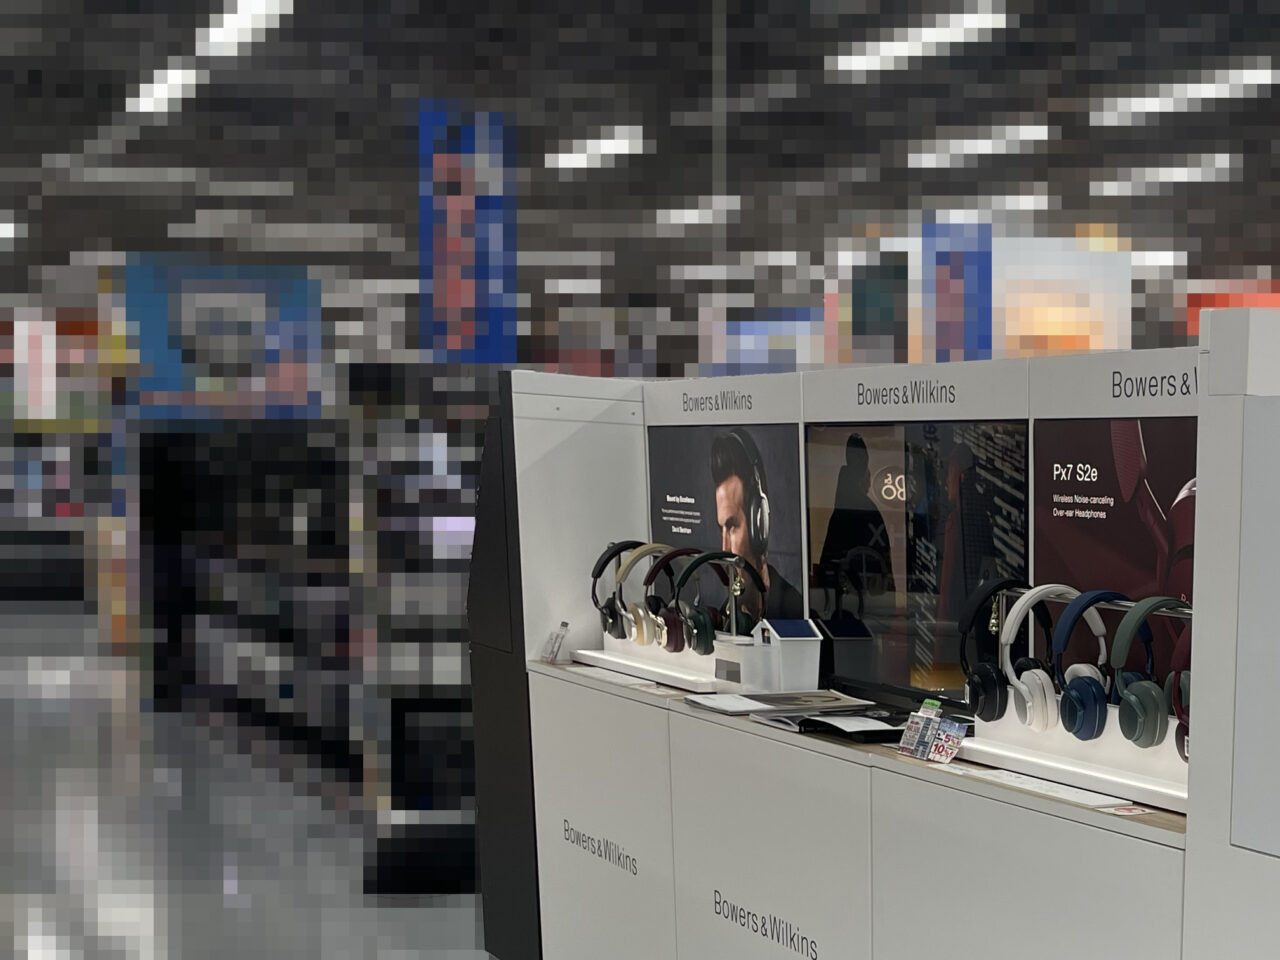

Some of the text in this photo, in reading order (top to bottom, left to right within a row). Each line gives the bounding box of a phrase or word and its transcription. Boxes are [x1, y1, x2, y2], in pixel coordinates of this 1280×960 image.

[857, 382, 900, 406] Bowers
[910, 380, 956, 404] Wilkins
[1112, 370, 1177, 398] Bowers
[682, 392, 713, 412] Bowers
[720, 390, 752, 411] Wilkins
[1053, 463, 1098, 482] Px7 S2e
[1053, 494, 1073, 503] Wireless
[563, 818, 596, 855] Bowers
[603, 837, 637, 876] Wilkins
[714, 889, 759, 933] Bowers
[769, 913, 818, 960] Wilkins
